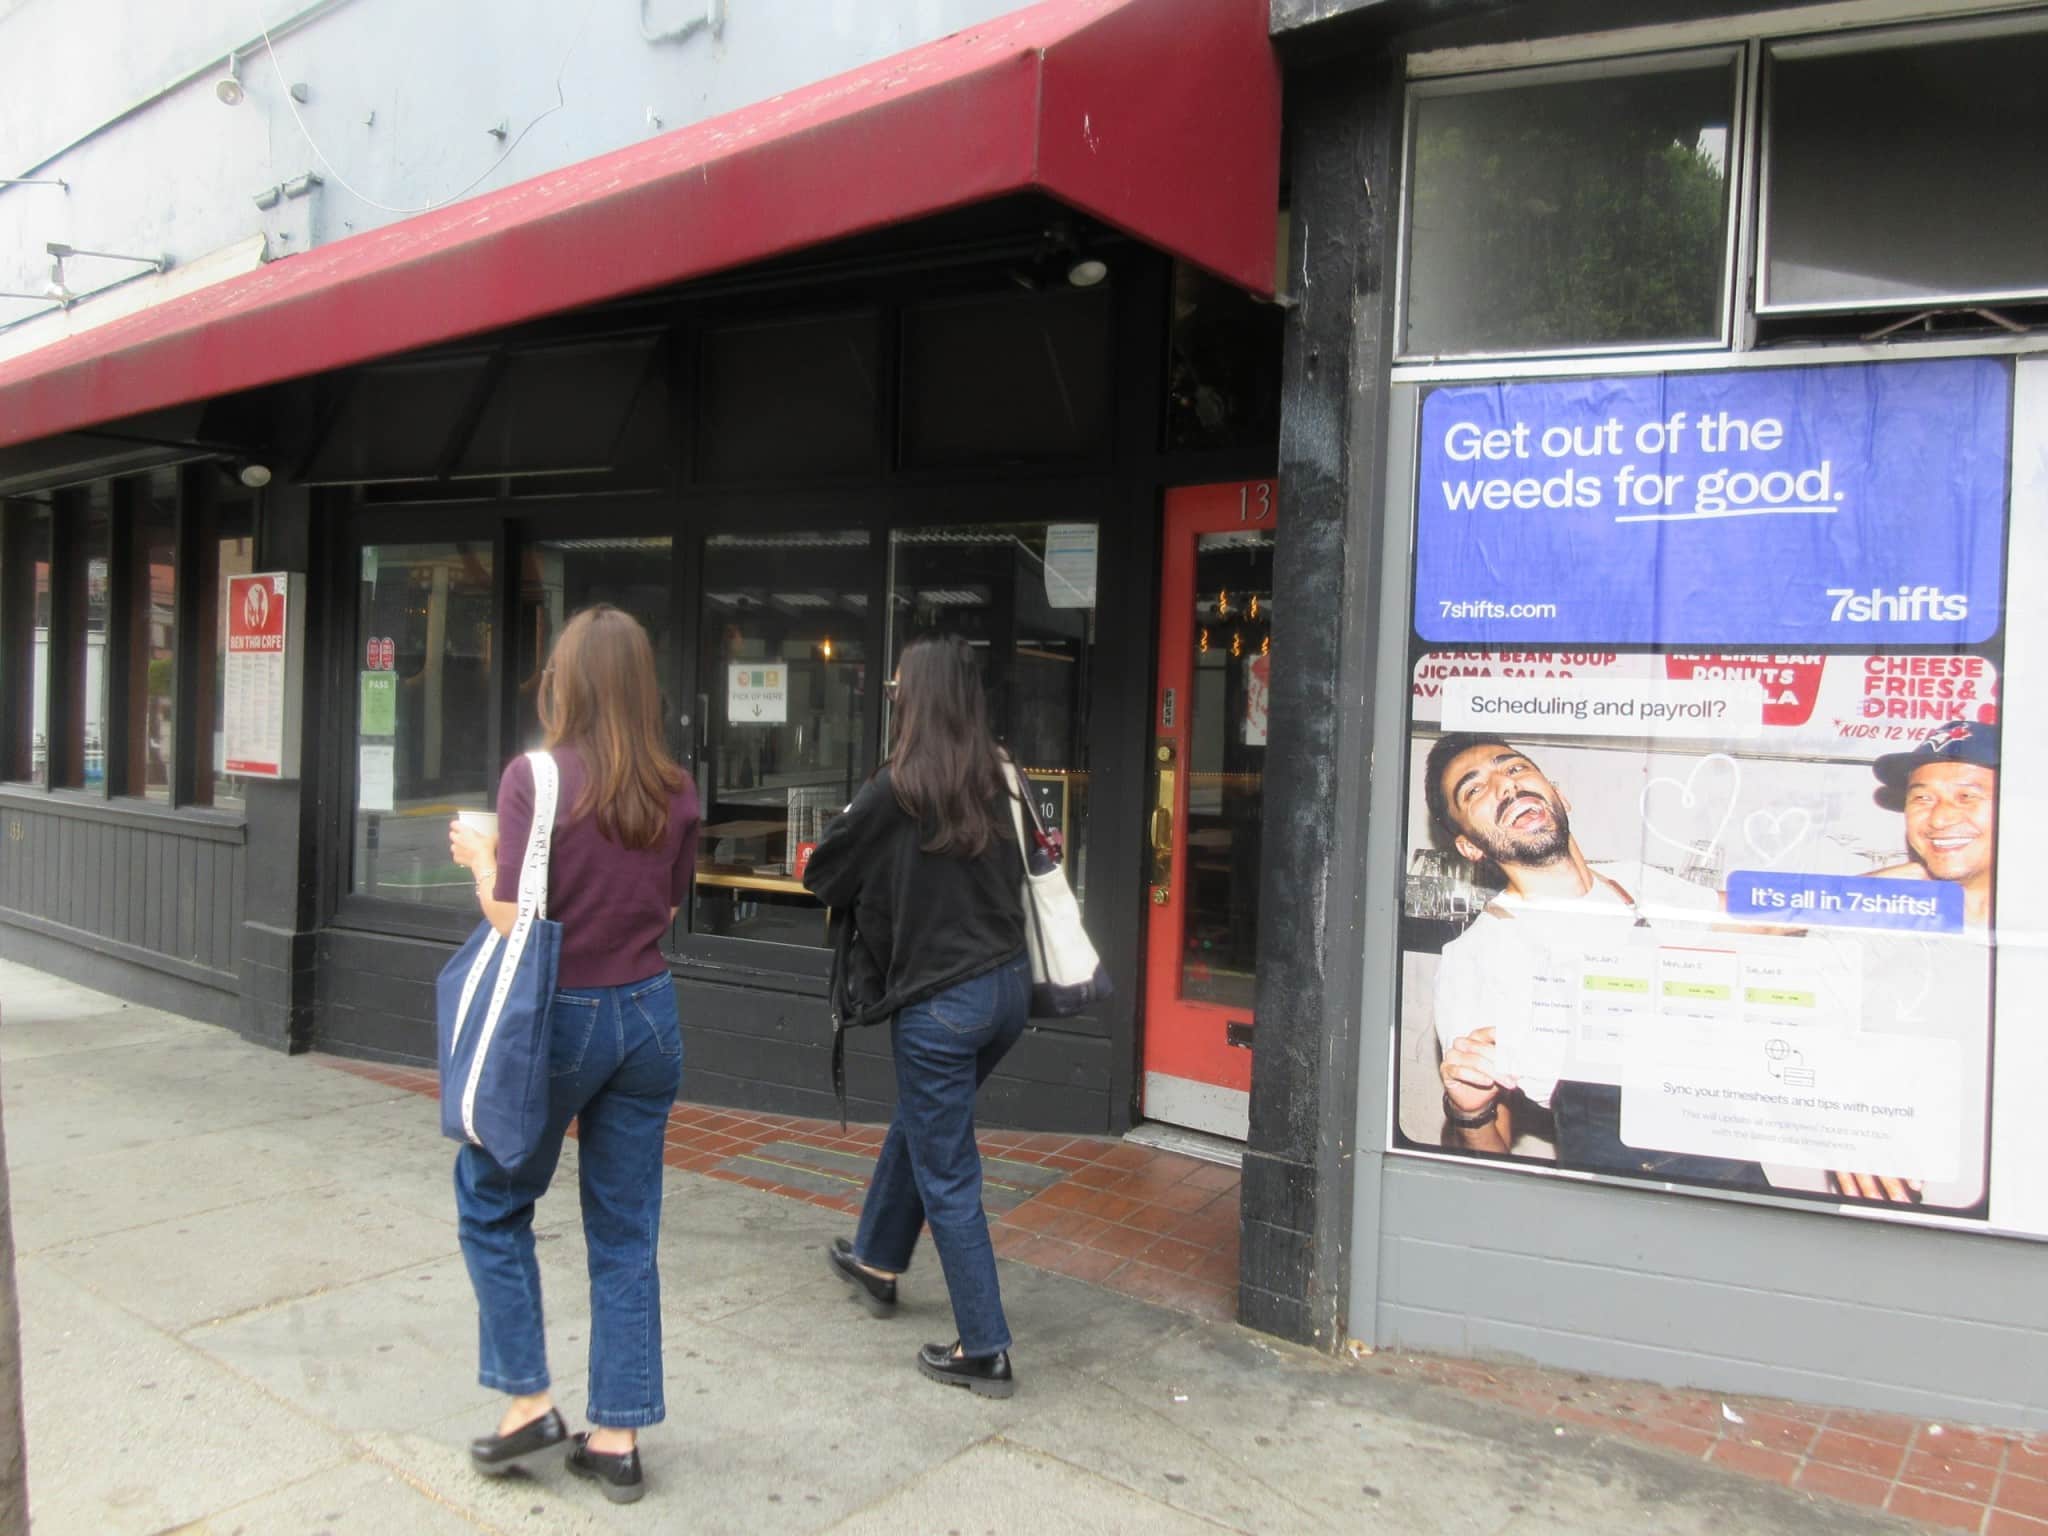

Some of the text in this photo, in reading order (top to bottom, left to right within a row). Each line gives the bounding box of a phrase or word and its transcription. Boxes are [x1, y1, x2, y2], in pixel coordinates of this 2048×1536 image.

[1444, 411, 1784, 461] Get out of the
[1441, 460, 1845, 514] weeds for good.
[1439, 600, 1557, 619] 7shifts.com
[1825, 586, 1968, 622] 7shifts
[262, 634, 282, 649] CAFE
[1499, 652, 1553, 664] BEAN
[1560, 652, 1617, 666] SOUP
[1864, 656, 1984, 678] CHEESE
[1418, 664, 1492, 680] JICAMA
[1692, 665, 1795, 685] DONUTS
[1413, 682, 1443, 698] AV
[1471, 695, 1727, 721] Scheduling and payroll?
[1862, 697, 1967, 721] DRINK
[1884, 726, 1903, 740] 12
[1751, 887, 1937, 917] It's all in 7shifts!
[1662, 1081, 1693, 1096] Sync
[1694, 1086, 1720, 1098] your
[1722, 1088, 1790, 1105] timesheets
[1791, 1095, 1816, 1107] and
[1842, 1101, 1869, 1113] with
[1871, 1104, 1914, 1118] payroll
